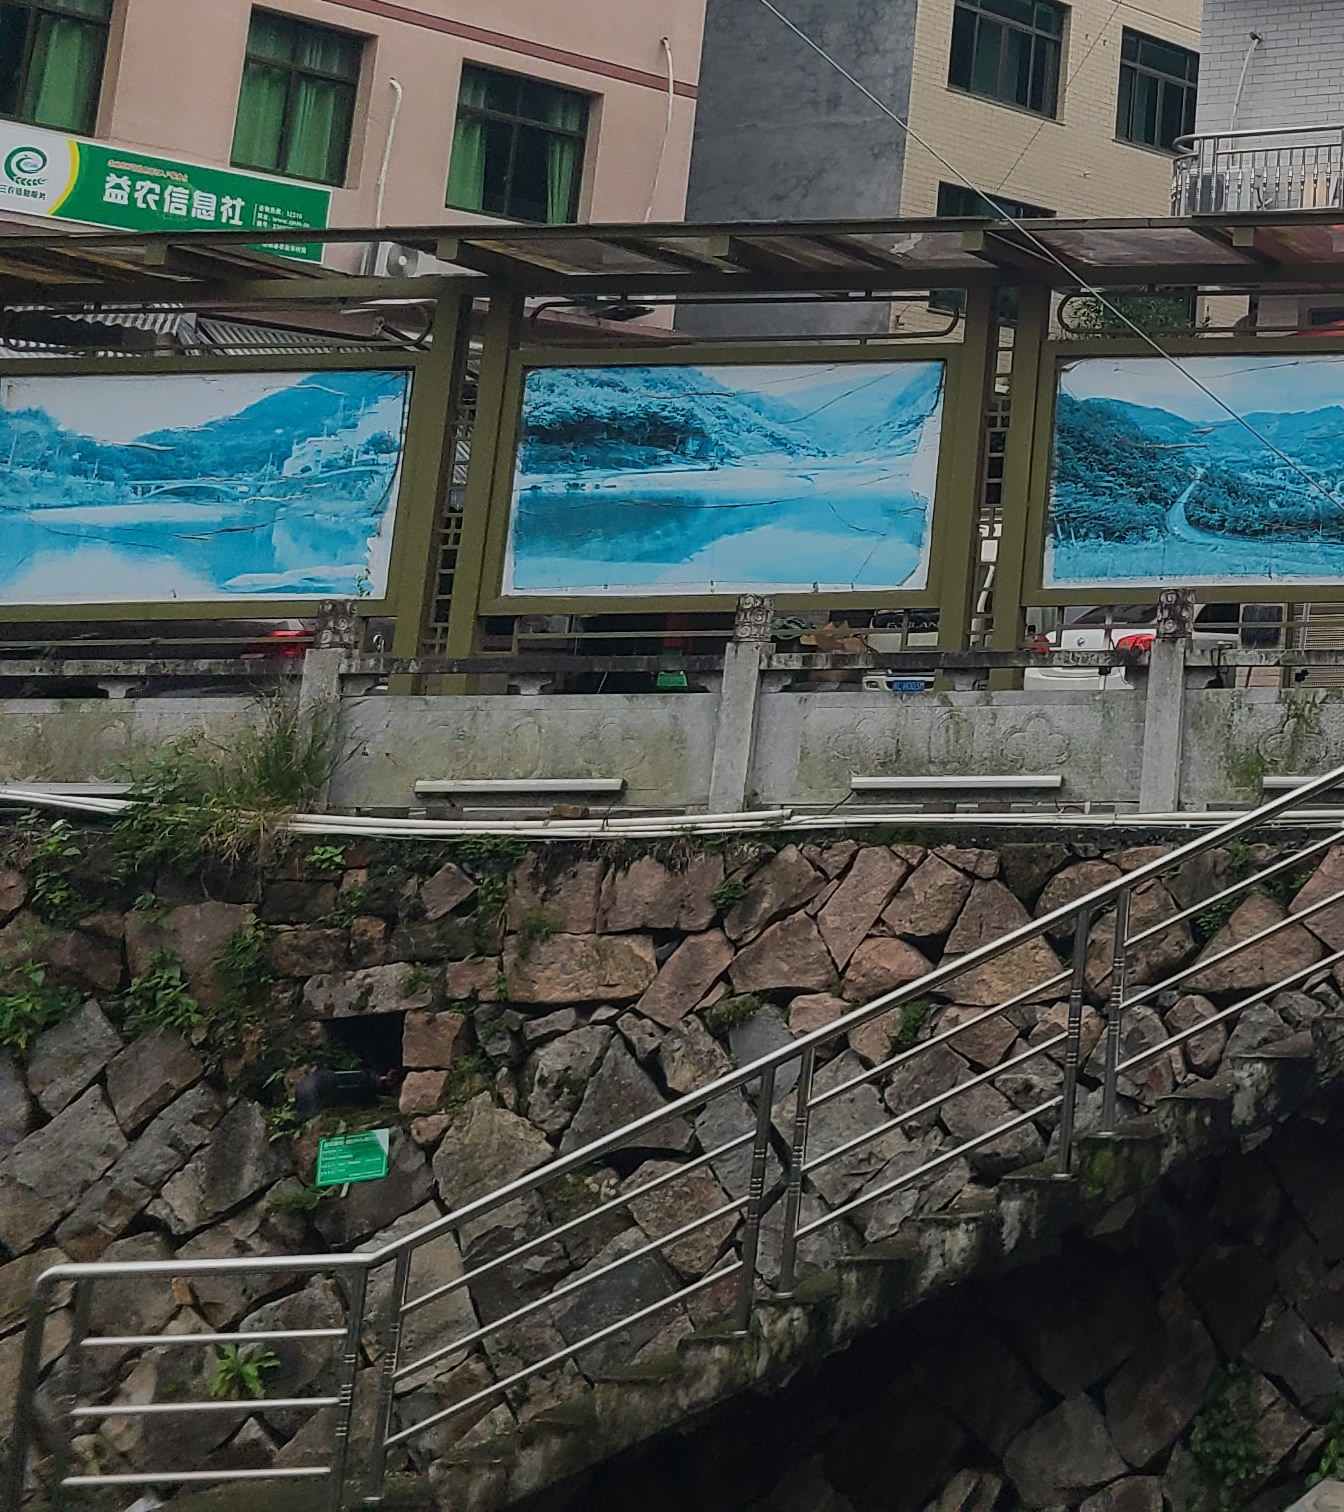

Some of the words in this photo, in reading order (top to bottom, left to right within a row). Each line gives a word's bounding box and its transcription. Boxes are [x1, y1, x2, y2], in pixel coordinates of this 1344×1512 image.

[102, 172, 246, 226] 益农信息社
